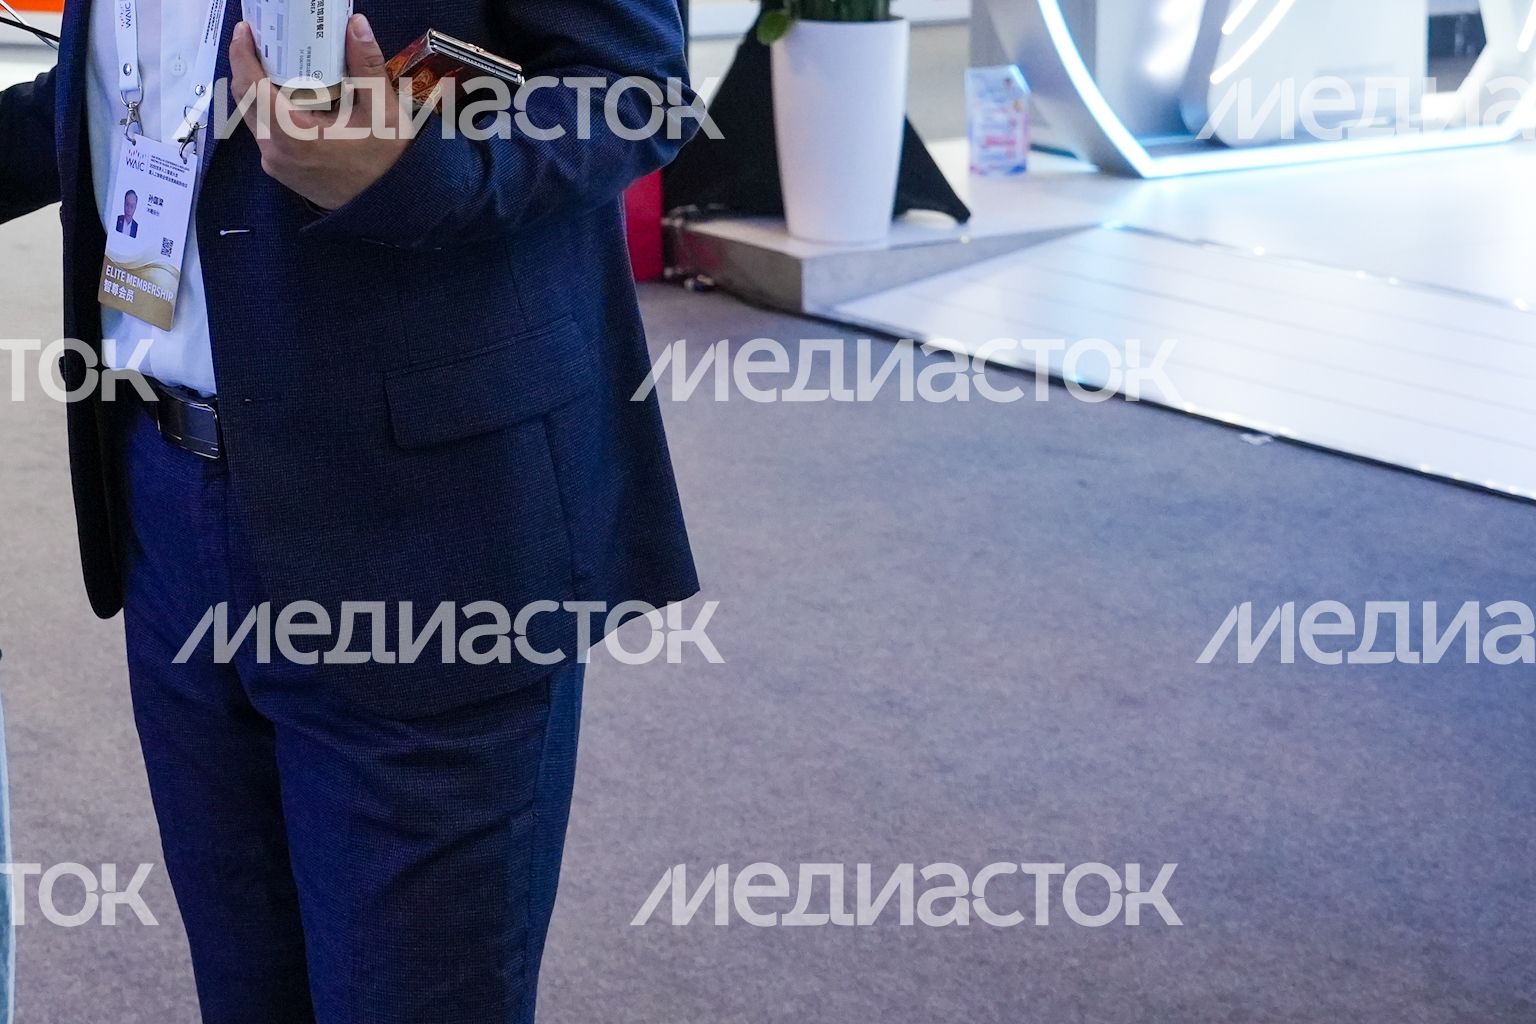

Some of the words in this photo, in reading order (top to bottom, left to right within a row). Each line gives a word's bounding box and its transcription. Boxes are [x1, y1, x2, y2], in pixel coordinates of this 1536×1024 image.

[124, 2, 132, 29] WAIC
[125, 156, 145, 172] WAIC
[105, 264, 125, 282] ELITE
[126, 273, 174, 302] MEMBERSHIP
